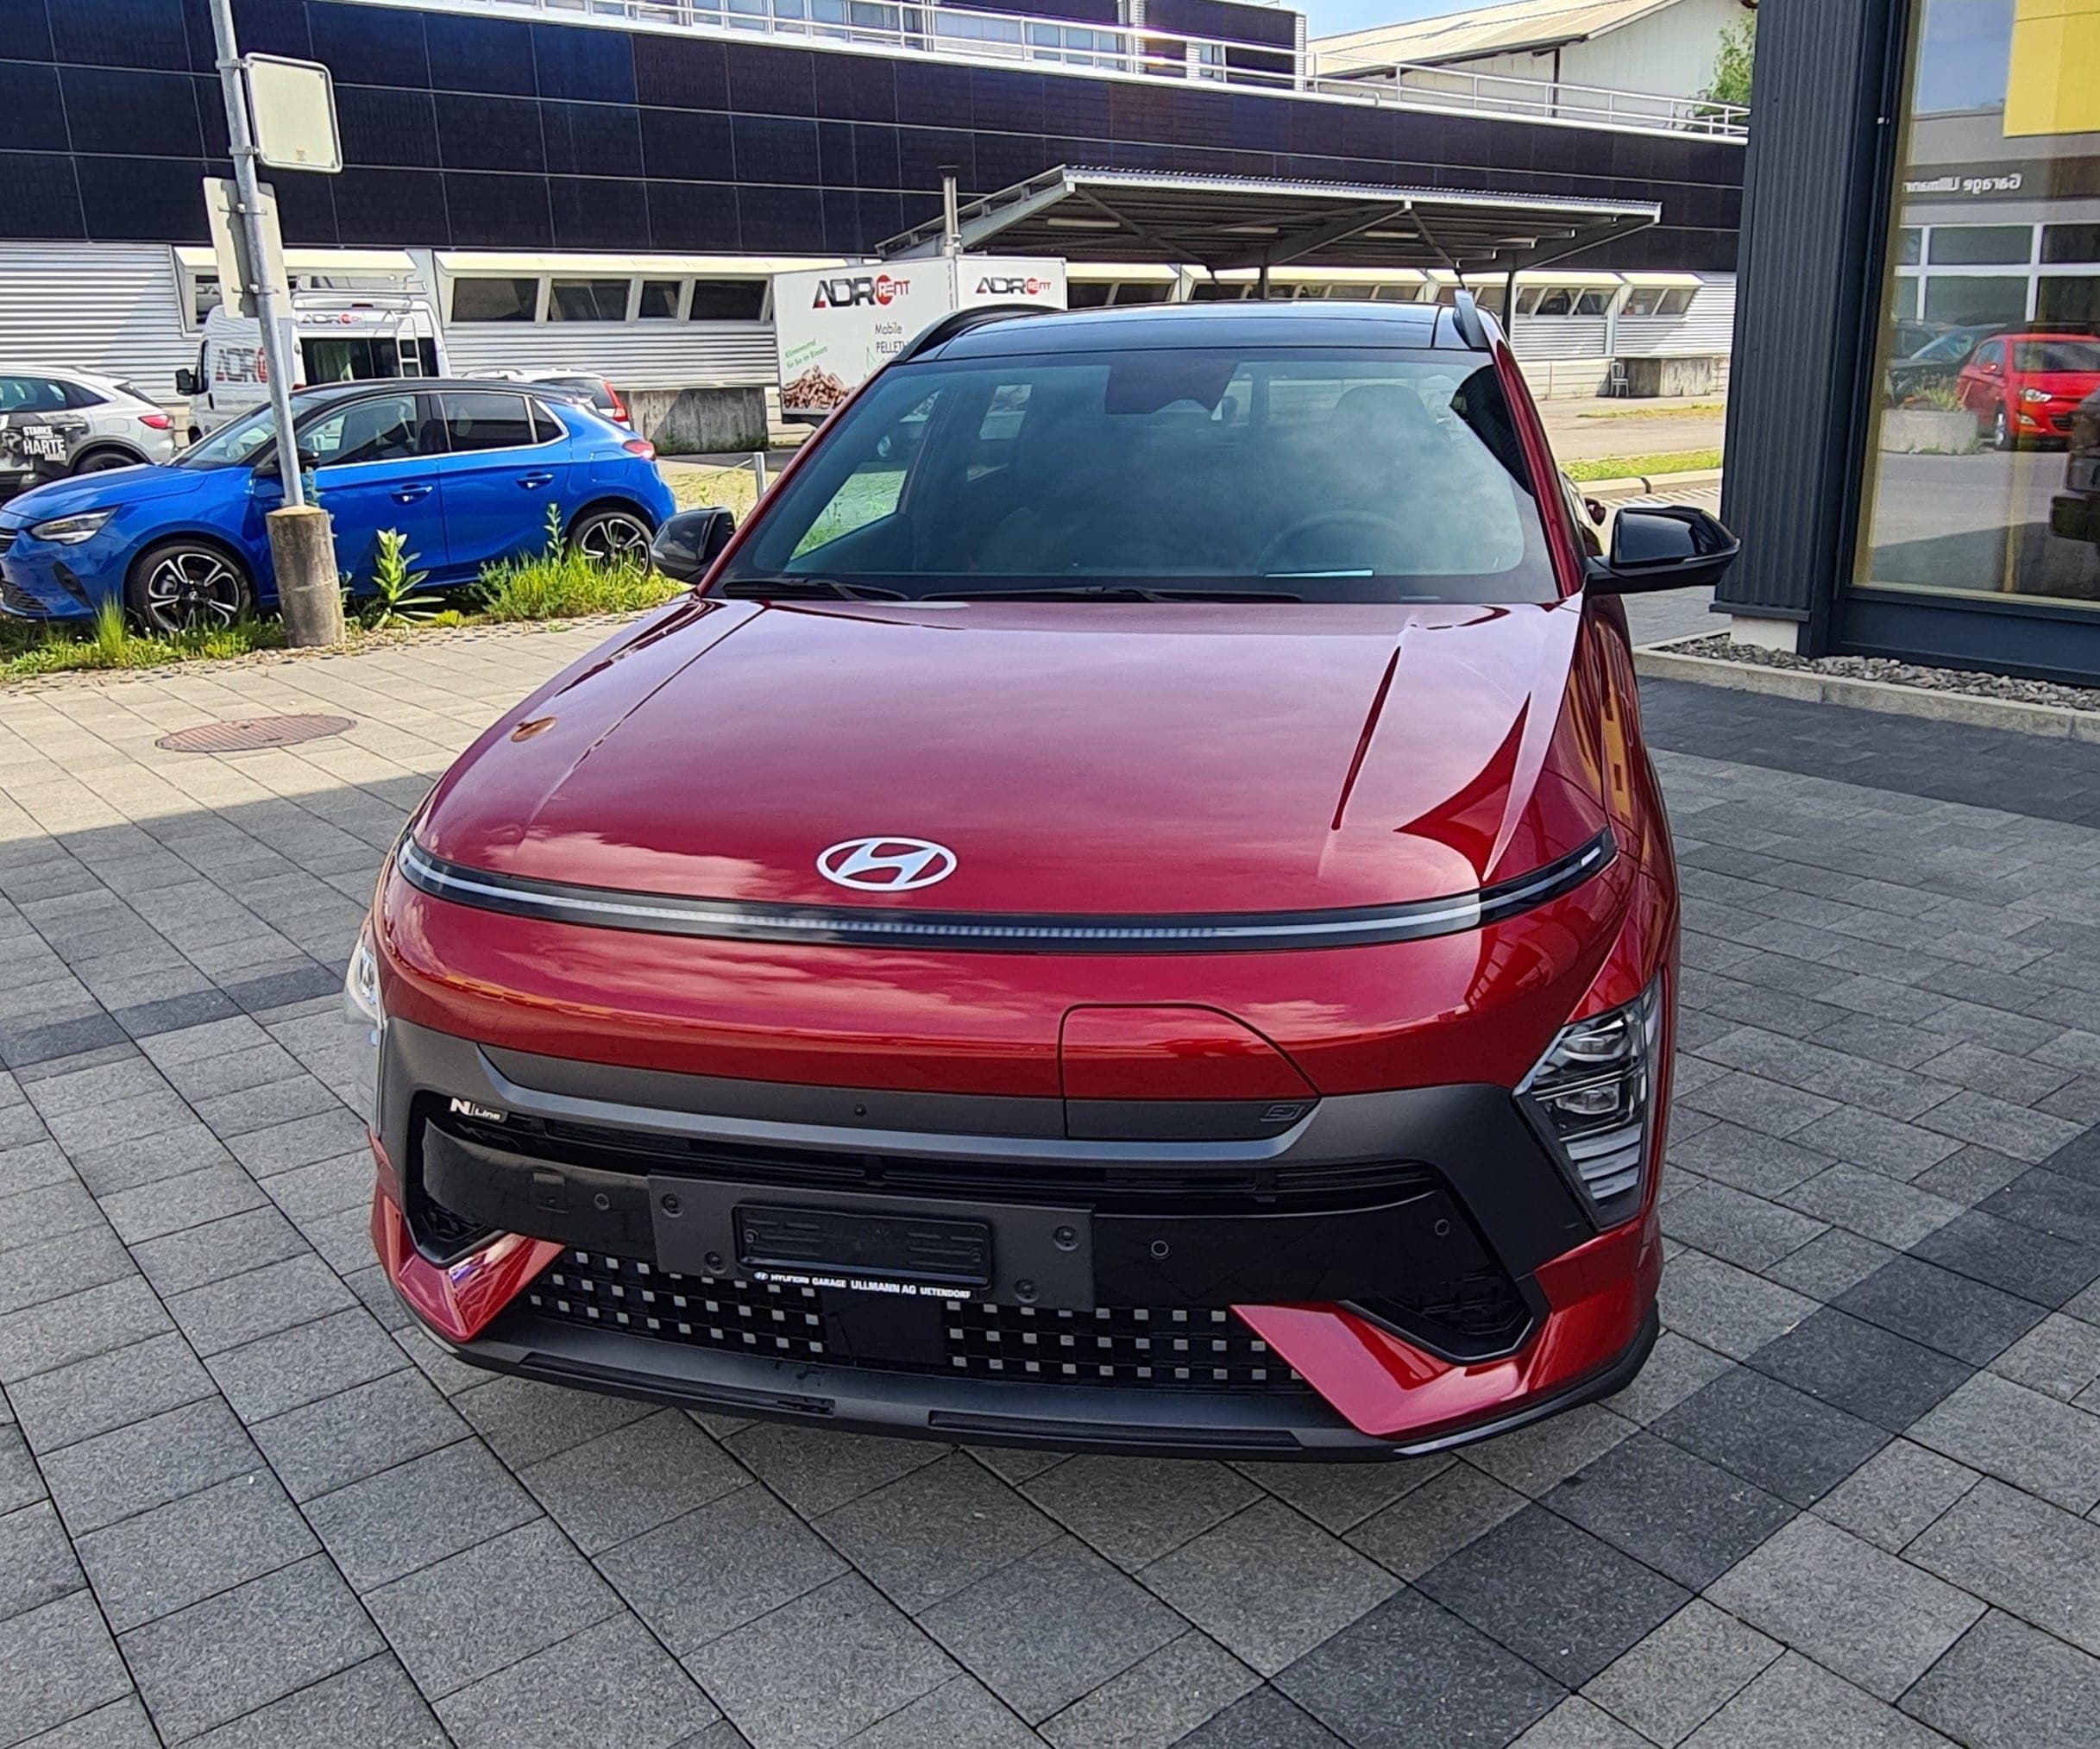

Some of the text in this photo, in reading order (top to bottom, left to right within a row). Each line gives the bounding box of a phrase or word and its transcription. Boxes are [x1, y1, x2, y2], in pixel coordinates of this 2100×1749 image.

[875, 322, 902, 334] Mobile
[22, 438, 65, 455] HARTE
[450, 1098, 471, 1116] N
[812, 1277, 846, 1288] GARAGE
[851, 1280, 899, 1293] ULLMANN
[902, 1284, 916, 1294] AG
[920, 1287, 971, 1299] UETENDORF
